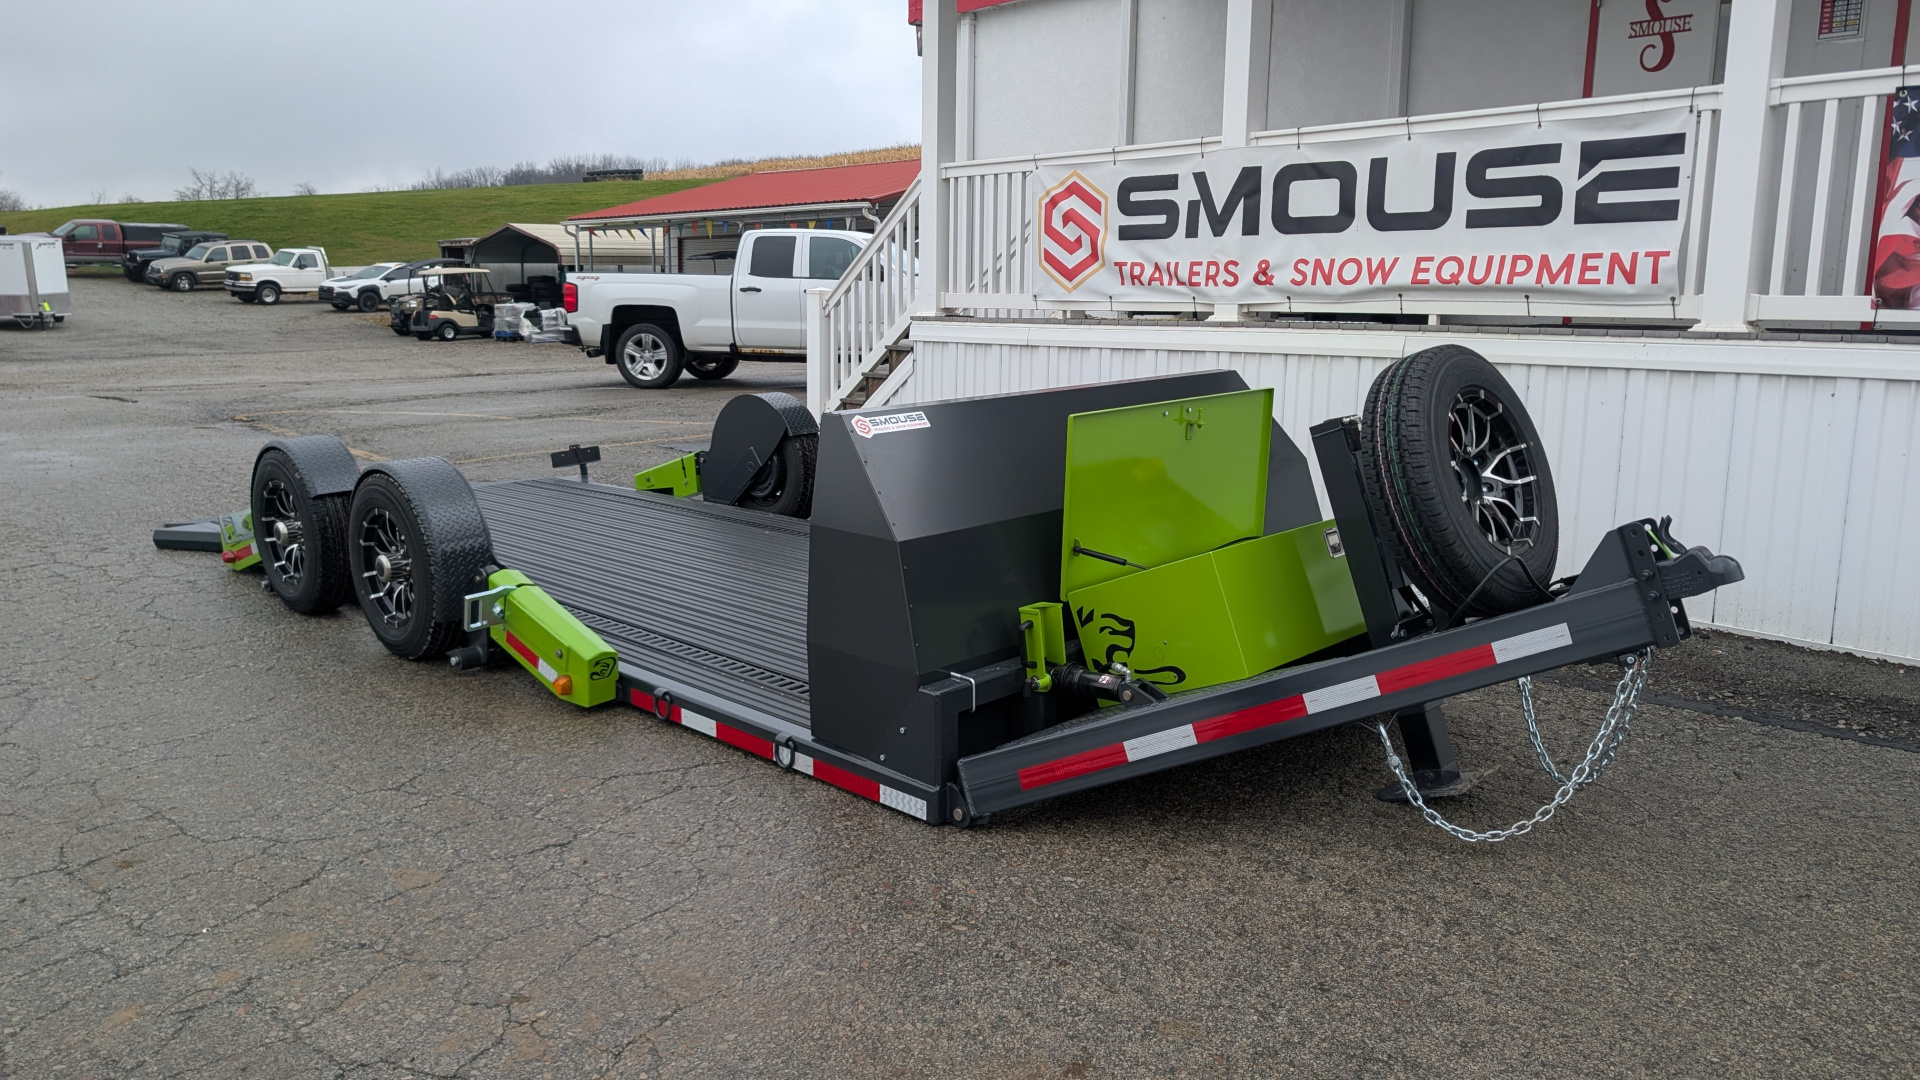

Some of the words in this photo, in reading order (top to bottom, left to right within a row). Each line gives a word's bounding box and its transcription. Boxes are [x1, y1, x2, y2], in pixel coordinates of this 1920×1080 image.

[1628, 16, 1692, 37] SMOUSE
[1116, 131, 1687, 241] SMOUSE
[1113, 259, 1240, 288] TRAILERS
[1252, 258, 1275, 287] &
[1289, 256, 1400, 287] SNOW
[1410, 250, 1671, 287] EQUIPMENT
[868, 413, 926, 427] SMOUSE
